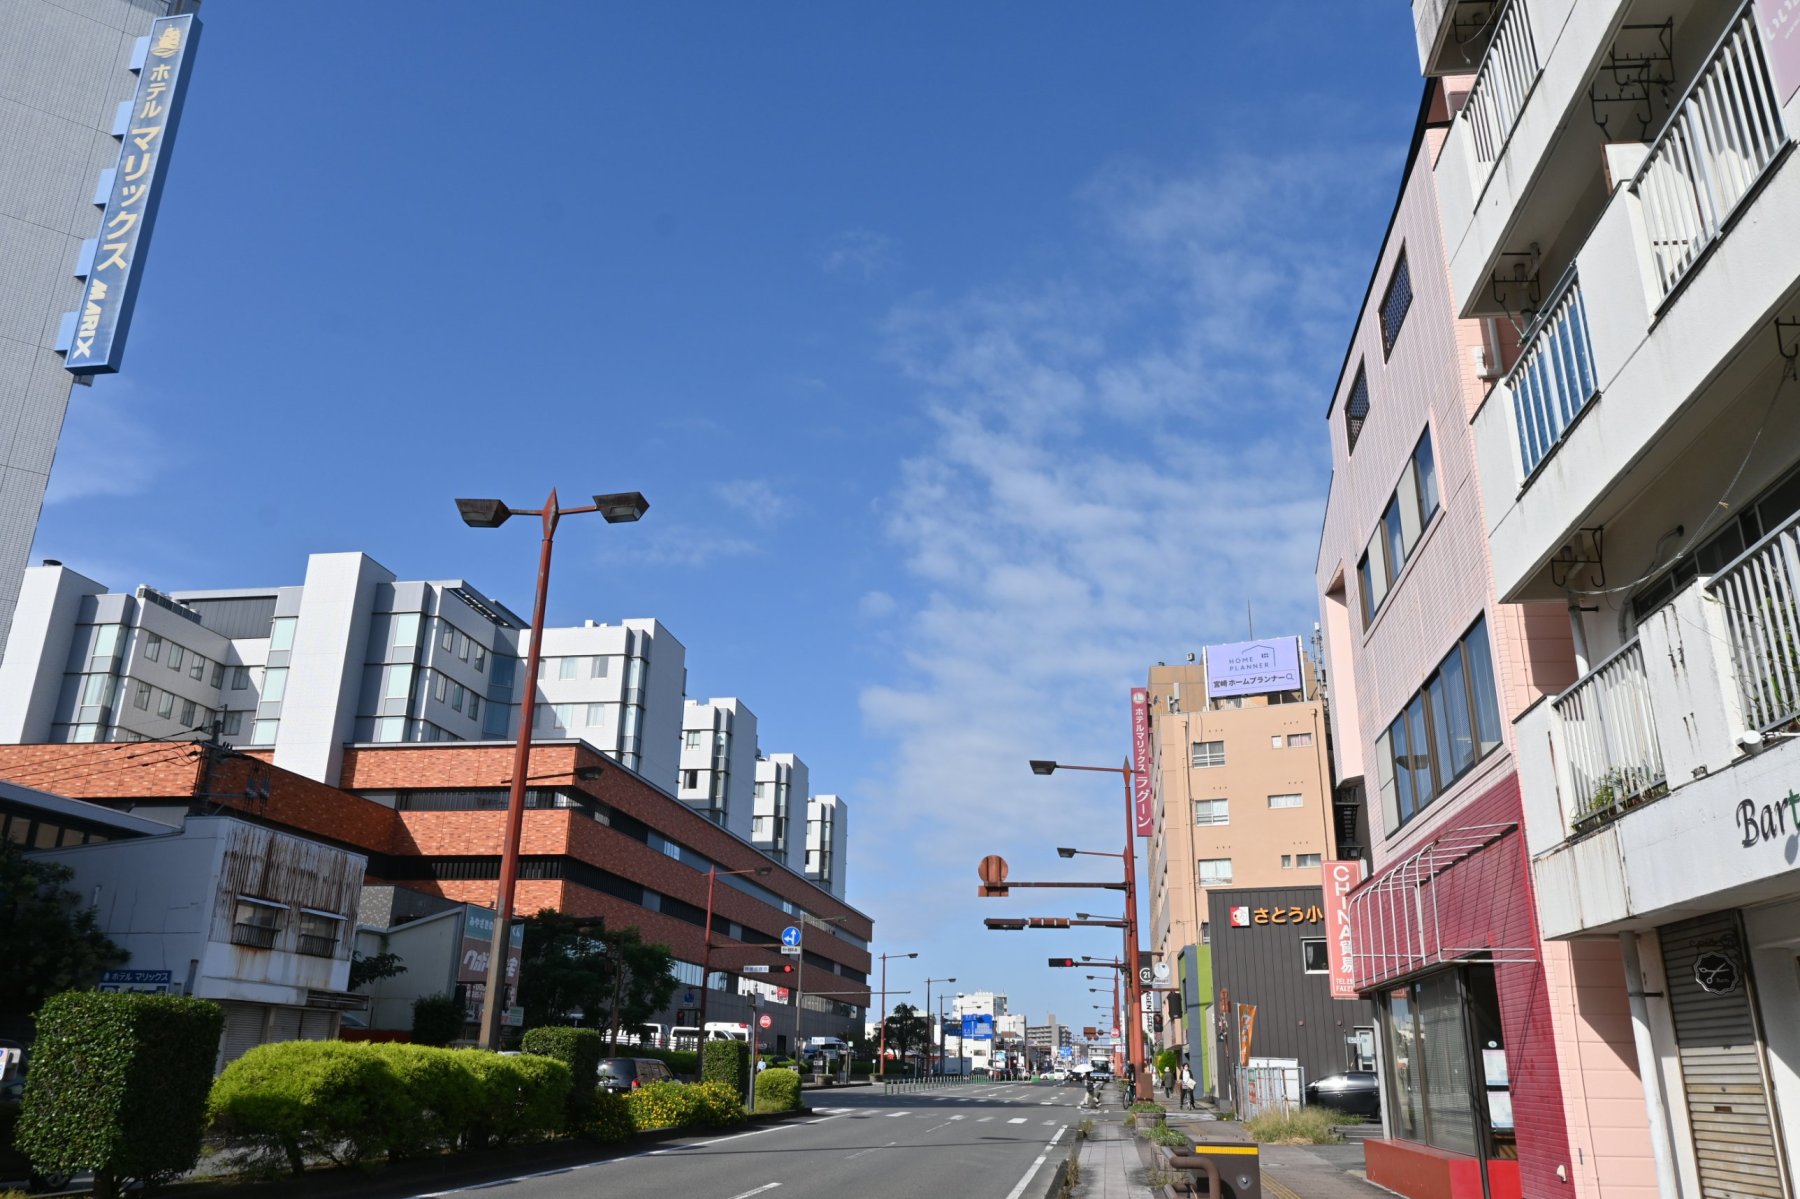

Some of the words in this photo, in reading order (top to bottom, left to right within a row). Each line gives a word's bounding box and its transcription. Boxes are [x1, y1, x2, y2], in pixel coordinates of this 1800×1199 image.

[140, 64, 171, 119] ホテル
[97, 126, 161, 272] マリックス
[73, 278, 108, 359] MARIX
[1229, 656, 1254, 665] HOME
[1229, 662, 1269, 672] PLANNER
[1136, 776, 1151, 828] ラグーン
[1254, 905, 1324, 924] さとう小
[112, 972, 132, 981] ホテル
[136, 972, 168, 981] マリックス
